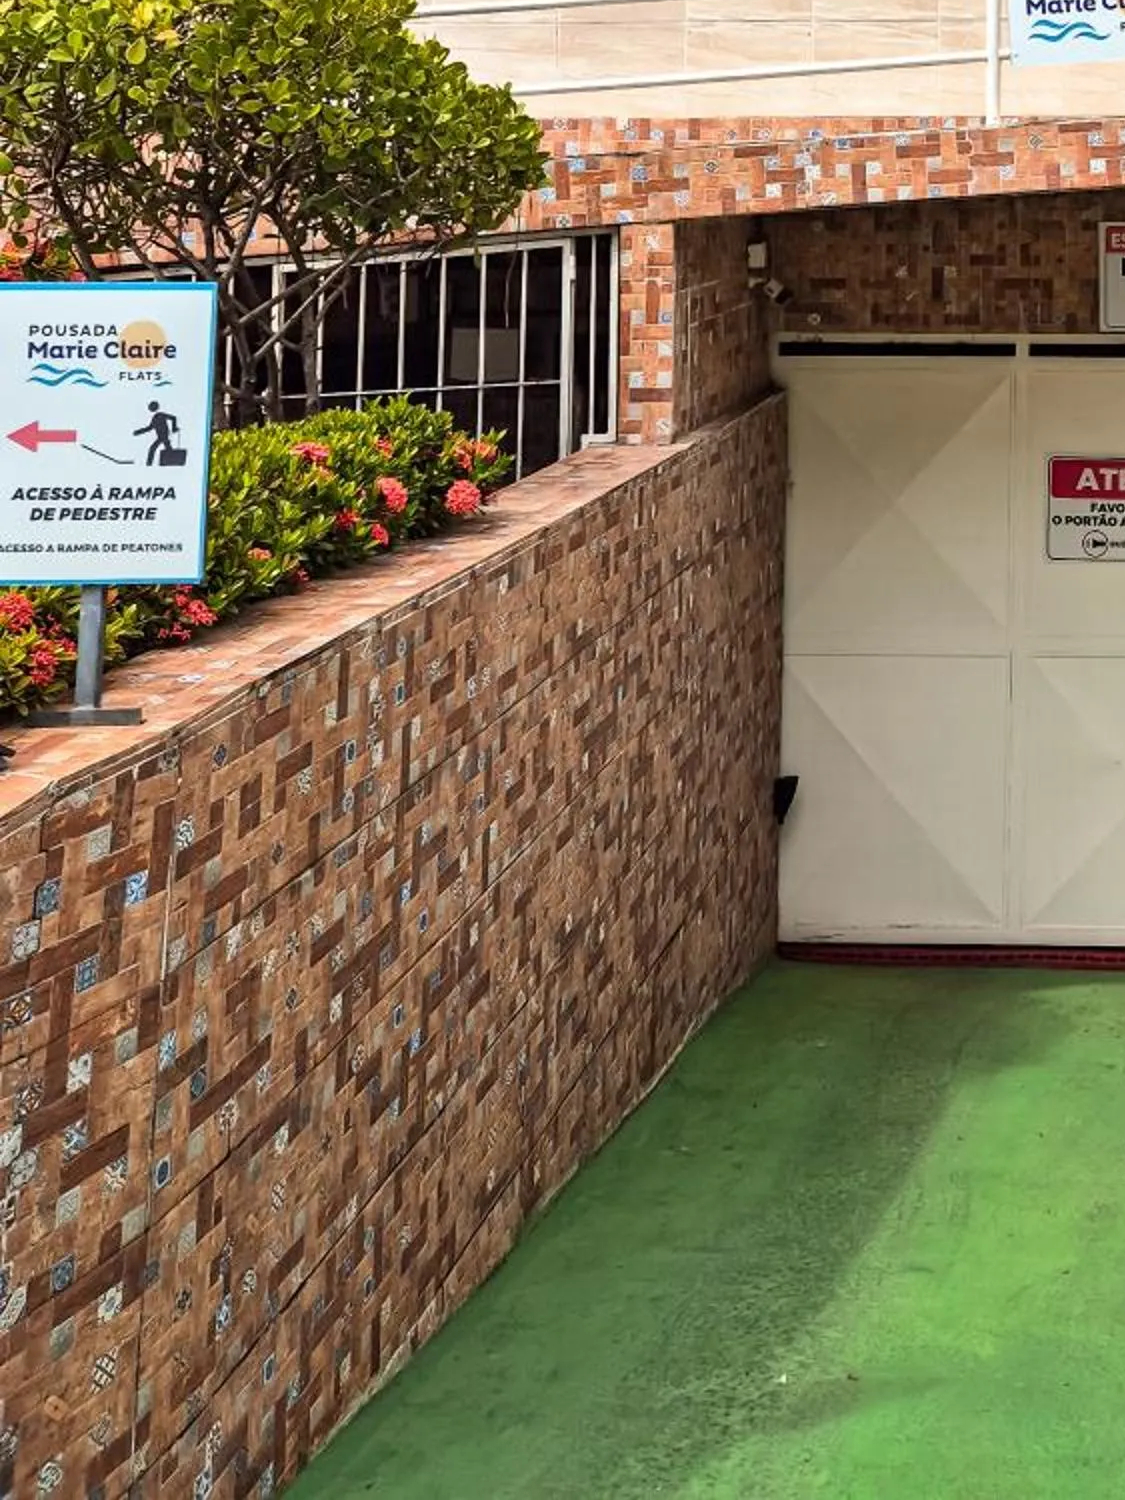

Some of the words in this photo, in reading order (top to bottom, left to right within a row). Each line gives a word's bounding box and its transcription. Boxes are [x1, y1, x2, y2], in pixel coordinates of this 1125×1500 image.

[29, 325, 118, 337] POUSADA
[27, 341, 97, 359] Marie
[103, 340, 177, 359] Claire
[118, 371, 162, 381] FLATS
[11, 487, 87, 501] ACESSO
[89, 483, 104, 501] À
[107, 486, 177, 501] RAMPA
[29, 507, 56, 521] DE
[59, 507, 158, 521] PEDESTRE
[1052, 517, 1062, 526] O
[1065, 513, 1117, 527] PORTÃO
[45, 543, 55, 553] A
[57, 543, 100, 553] RAMPA
[102, 543, 118, 553] DE
[121, 543, 183, 553] PEATONES
